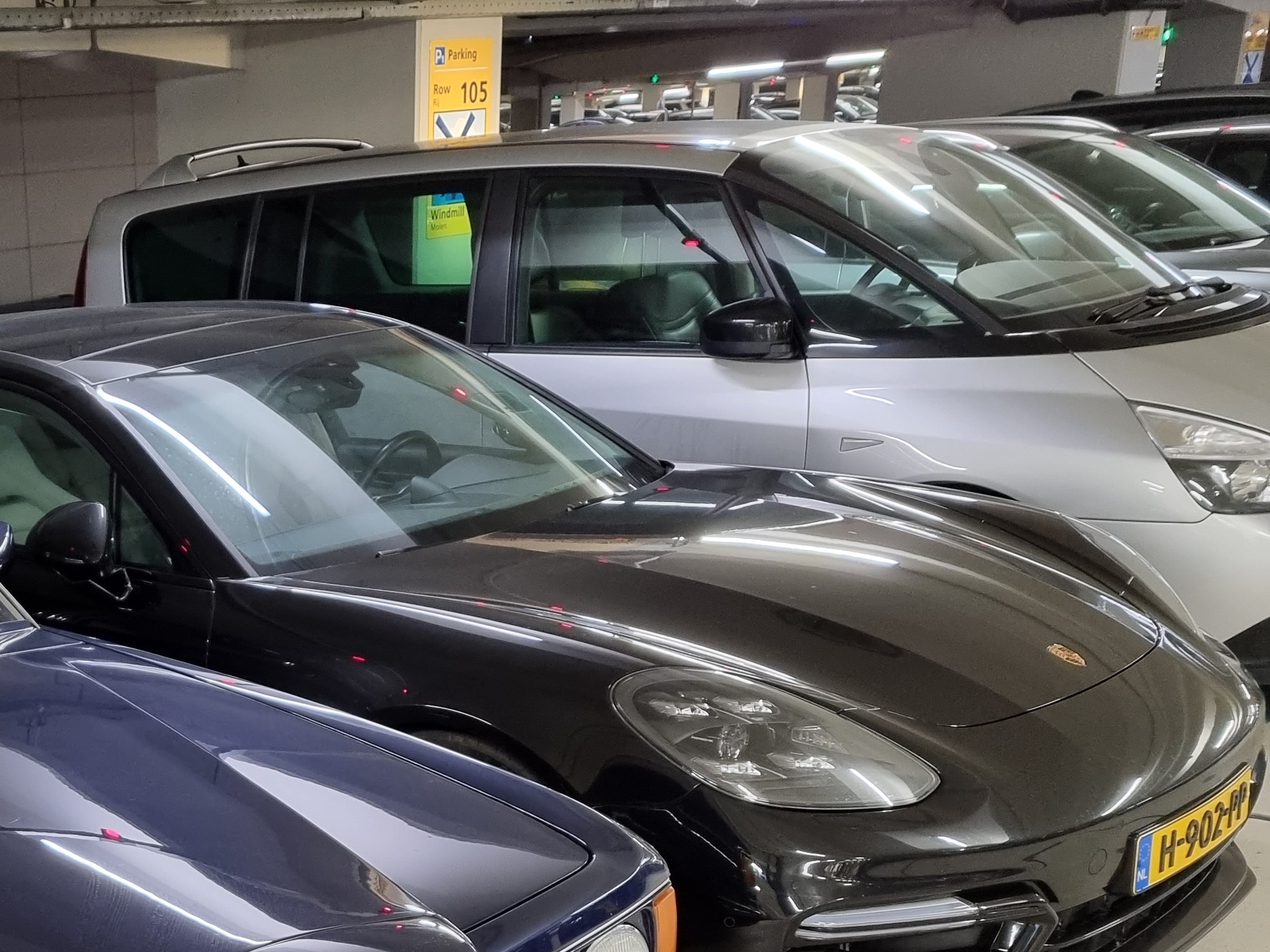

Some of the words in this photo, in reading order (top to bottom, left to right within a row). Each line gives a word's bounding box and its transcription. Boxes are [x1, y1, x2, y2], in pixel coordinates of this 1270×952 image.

[448, 48, 477, 62] Parking
[433, 84, 451, 95] Row
[461, 80, 488, 104] 105
[430, 205, 465, 221] Windmill
[1158, 781, 1248, 874] H-902-PP
[1136, 868, 1148, 883] NL
